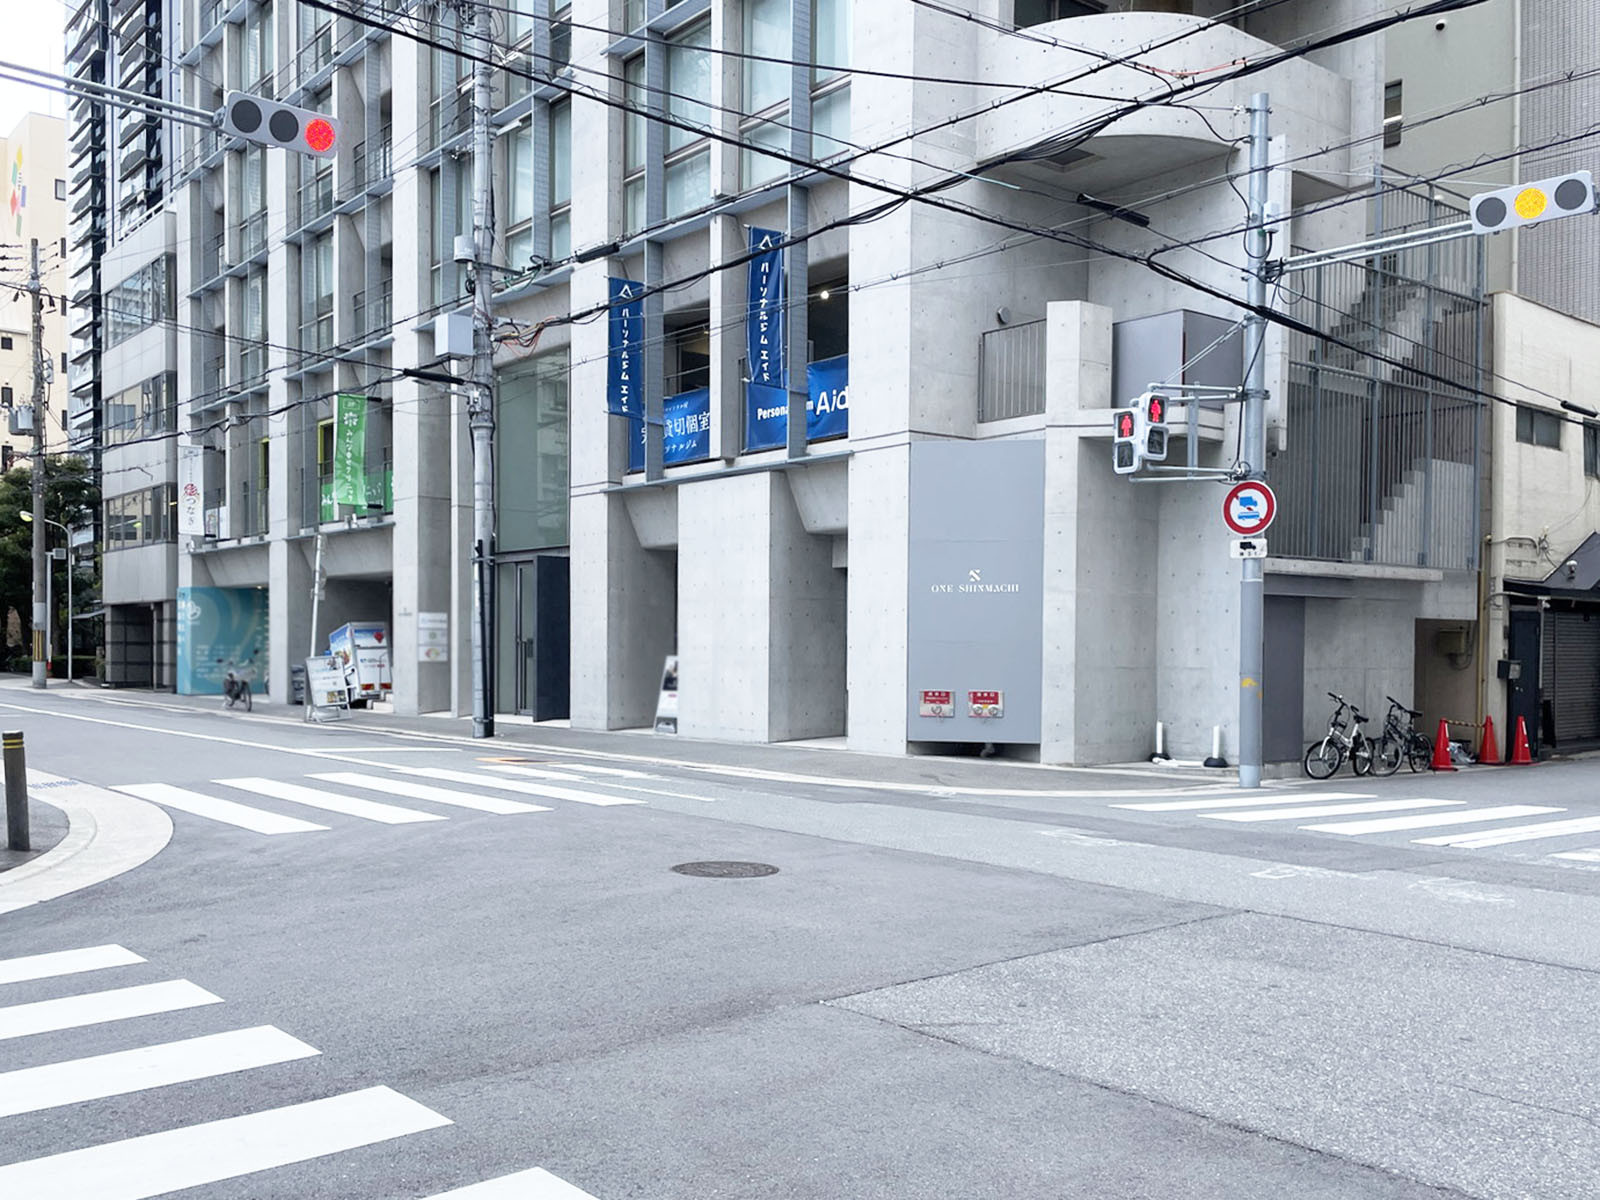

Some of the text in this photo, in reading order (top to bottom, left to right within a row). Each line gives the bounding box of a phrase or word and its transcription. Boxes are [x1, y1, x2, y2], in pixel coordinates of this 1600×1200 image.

[759, 262, 770, 382] パーソナルジム エイド
[620, 385, 630, 413] エイド
[756, 405, 789, 421] Persona
[815, 385, 849, 415] Aid
[930, 583, 1019, 592] ONE SHINMACHI
